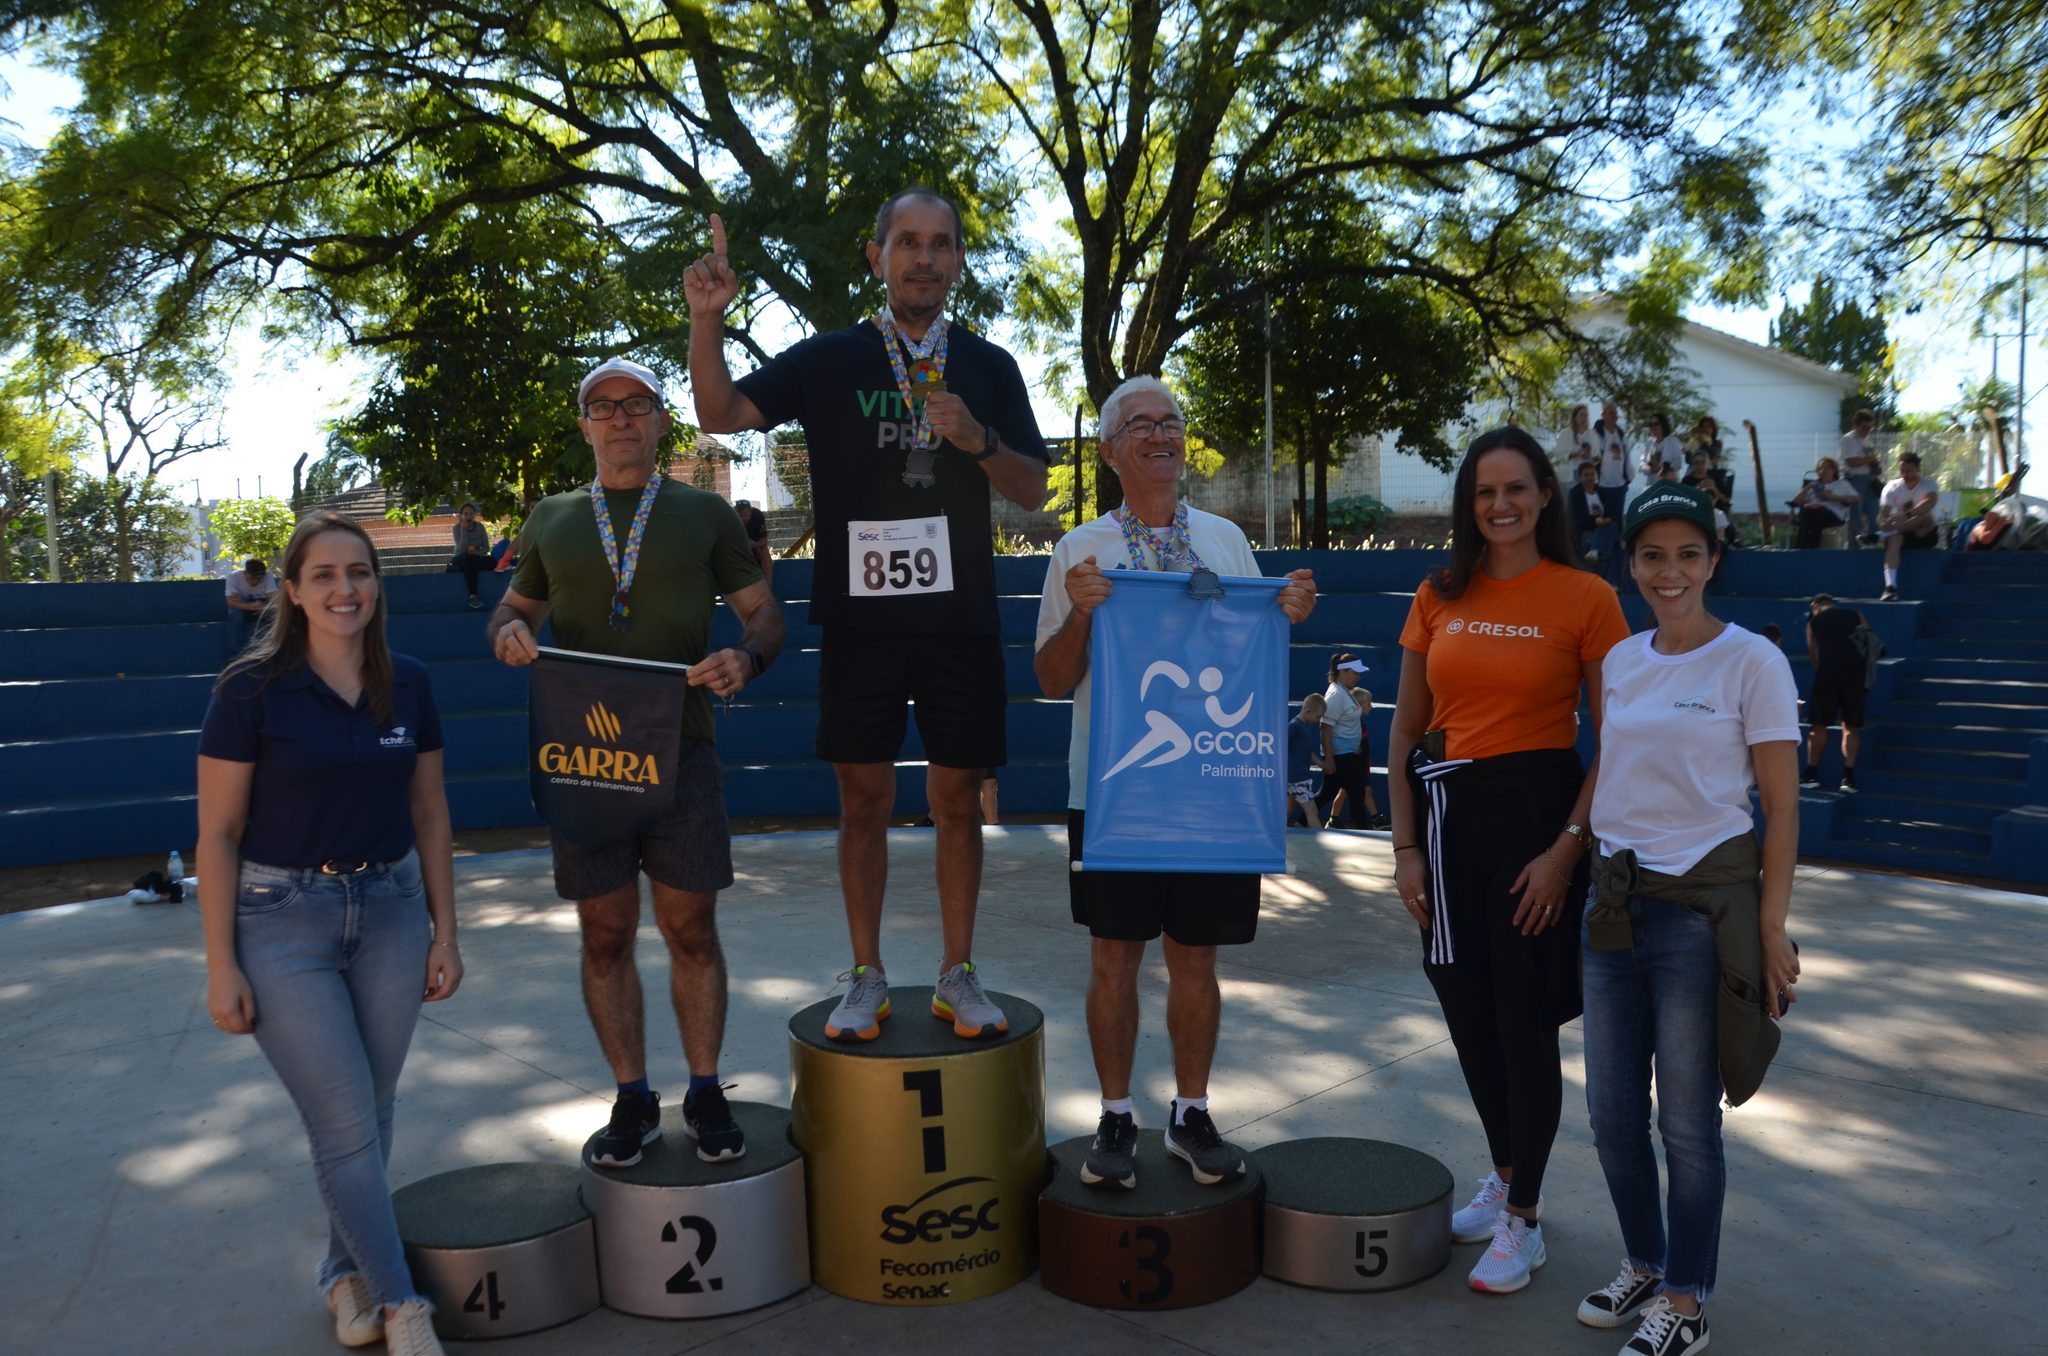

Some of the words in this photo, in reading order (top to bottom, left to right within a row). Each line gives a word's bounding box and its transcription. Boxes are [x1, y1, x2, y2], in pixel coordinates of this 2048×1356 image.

[1638, 497, 1660, 512] Casa
[1660, 494, 1698, 508] Branca
[863, 547, 938, 590] 859
[1468, 621, 1544, 638] CRESOL
[1193, 731, 1275, 755] GCOR
[538, 742, 660, 785] GARRA
[1201, 764, 1275, 778] Palmitinho
[550, 776, 579, 786] centro
[580, 778, 592, 787] de
[593, 780, 645, 793] treinamento
[902, 1069, 947, 1174] 1
[661, 1215, 724, 1294] 2
[880, 1247, 1001, 1277] Fecomércio
[1118, 1225, 1175, 1304] 3
[1354, 1230, 1389, 1278] 5
[463, 1270, 506, 1321] 4
[882, 1281, 952, 1300] Senac
